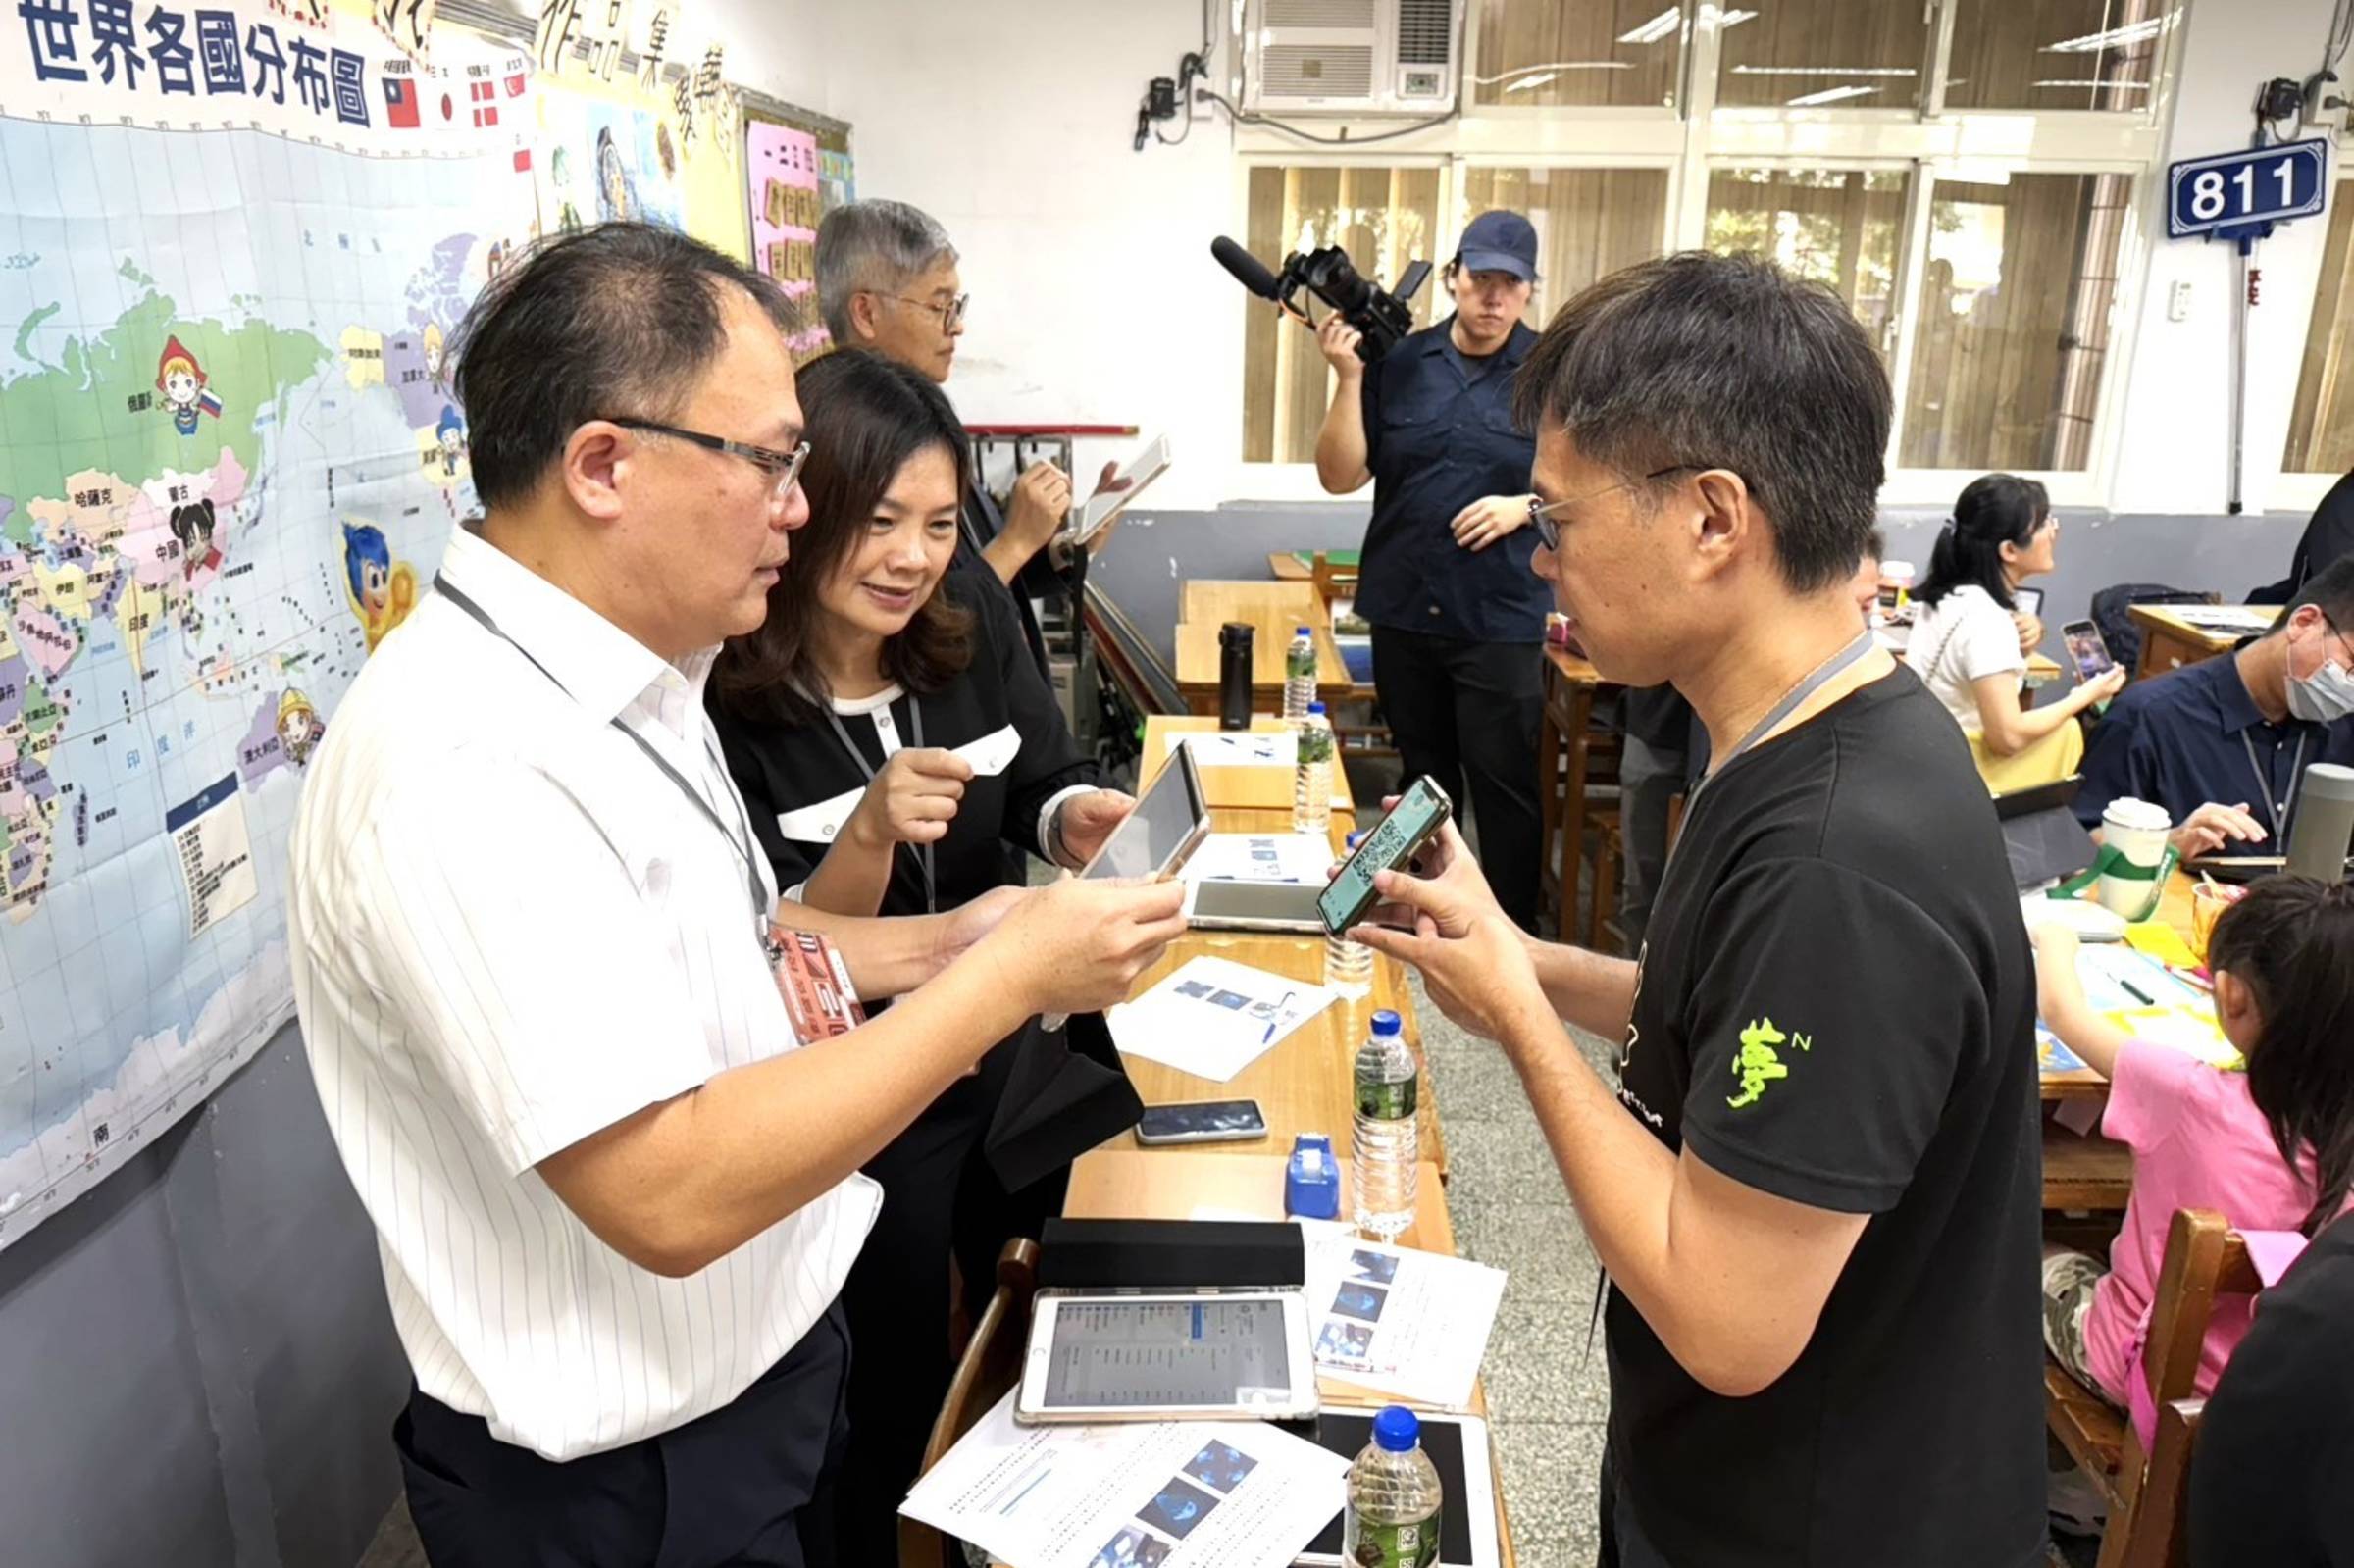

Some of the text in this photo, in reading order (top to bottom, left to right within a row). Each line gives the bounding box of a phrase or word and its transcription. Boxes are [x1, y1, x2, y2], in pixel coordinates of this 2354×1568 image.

[18, 0, 370, 128] 世界各國分布圖
[2191, 157, 2293, 220] 811
[74, 488, 113, 508] 哈薩克
[168, 484, 189, 503] 蒙古
[155, 539, 179, 563] 中國
[129, 613, 148, 632] 印度
[244, 736, 280, 765] 澳大利亞
[1791, 1032, 1812, 1051] N
[94, 1122, 110, 1147] 南
